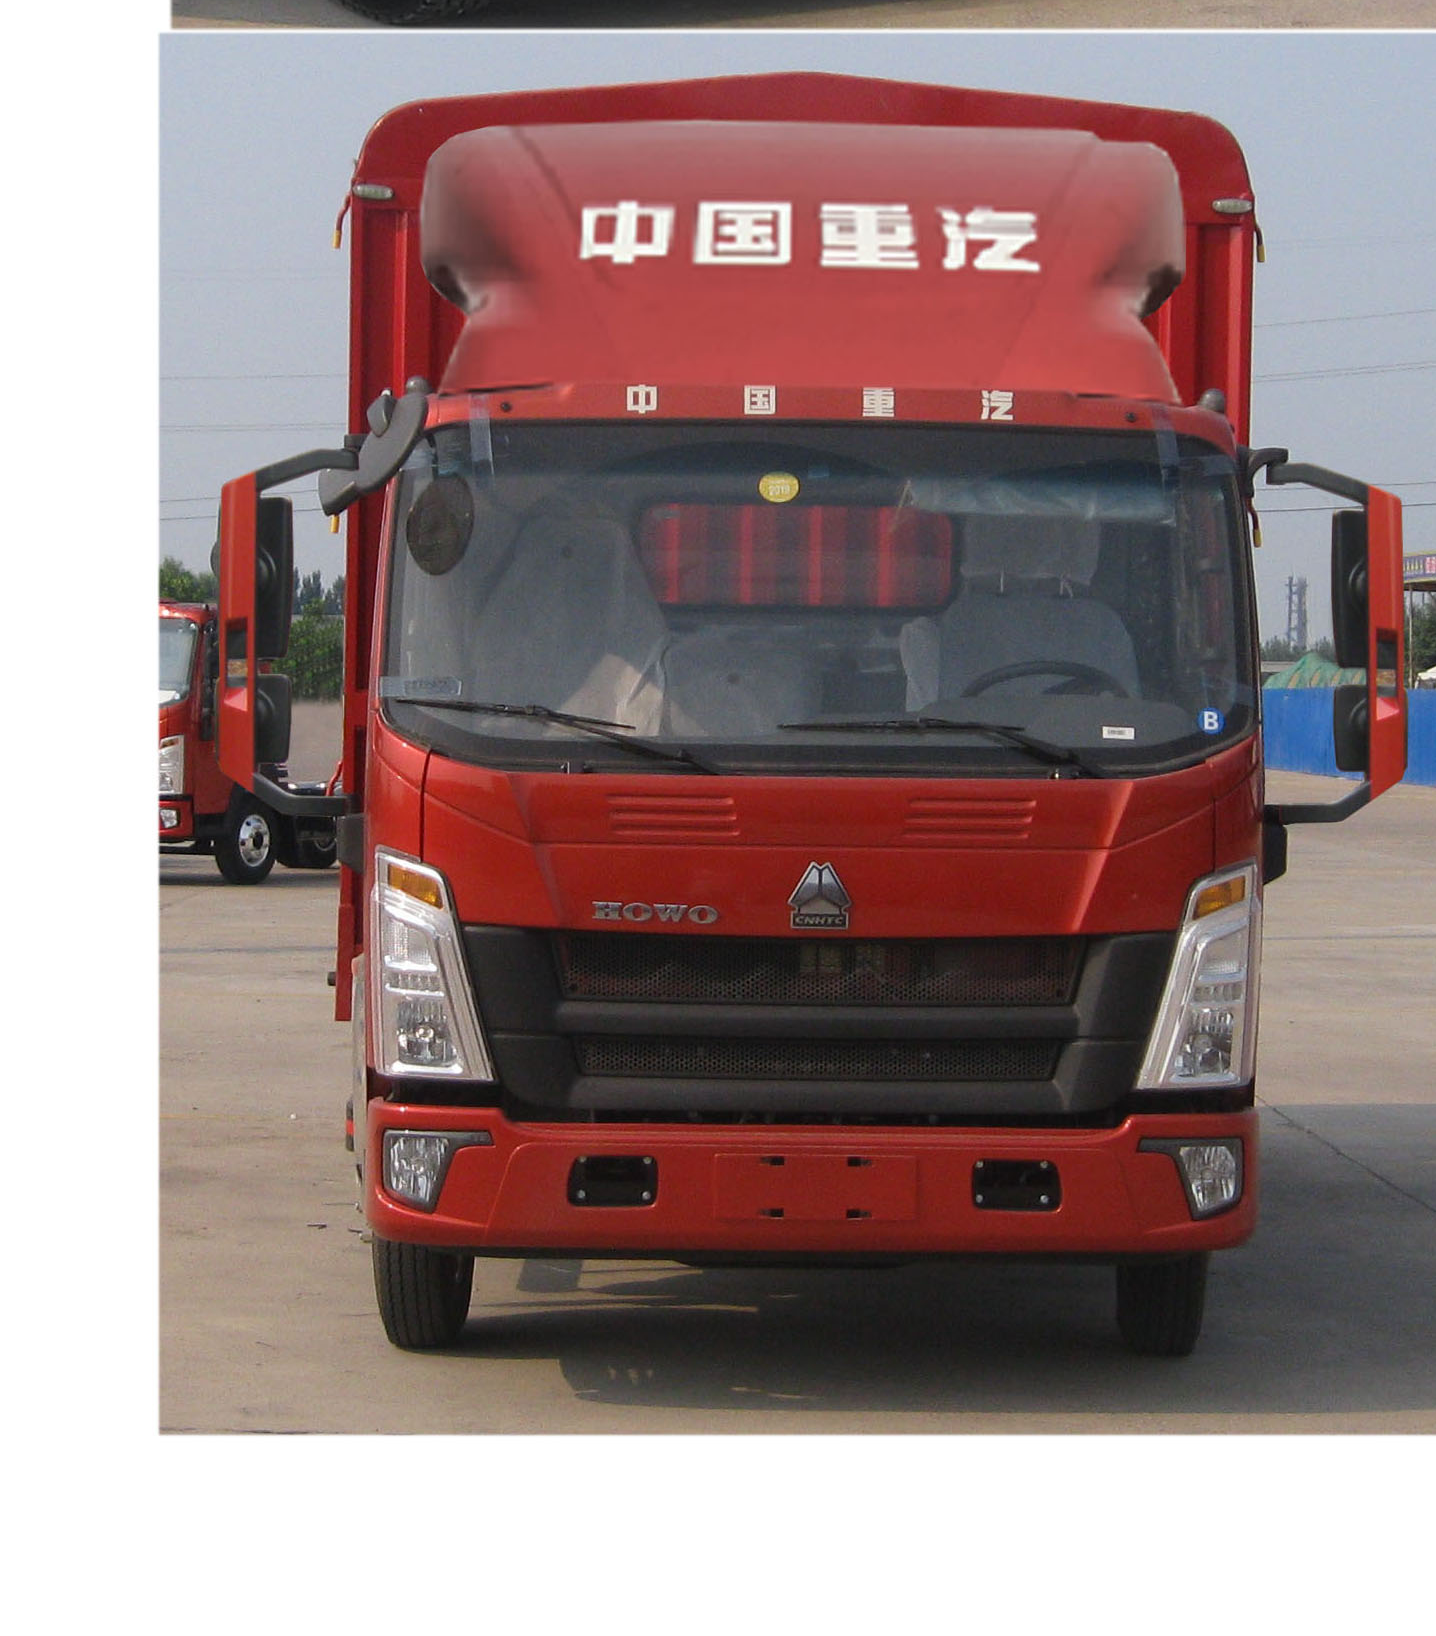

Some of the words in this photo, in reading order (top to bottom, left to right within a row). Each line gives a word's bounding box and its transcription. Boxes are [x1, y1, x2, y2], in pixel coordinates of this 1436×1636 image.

[580, 200, 1041, 272] 中国重汽
[626, 384, 1014, 421] 中国重汽
[1202, 710, 1220, 731] B
[591, 900, 719, 925] HOWO
[794, 915, 844, 926] CNHTC
